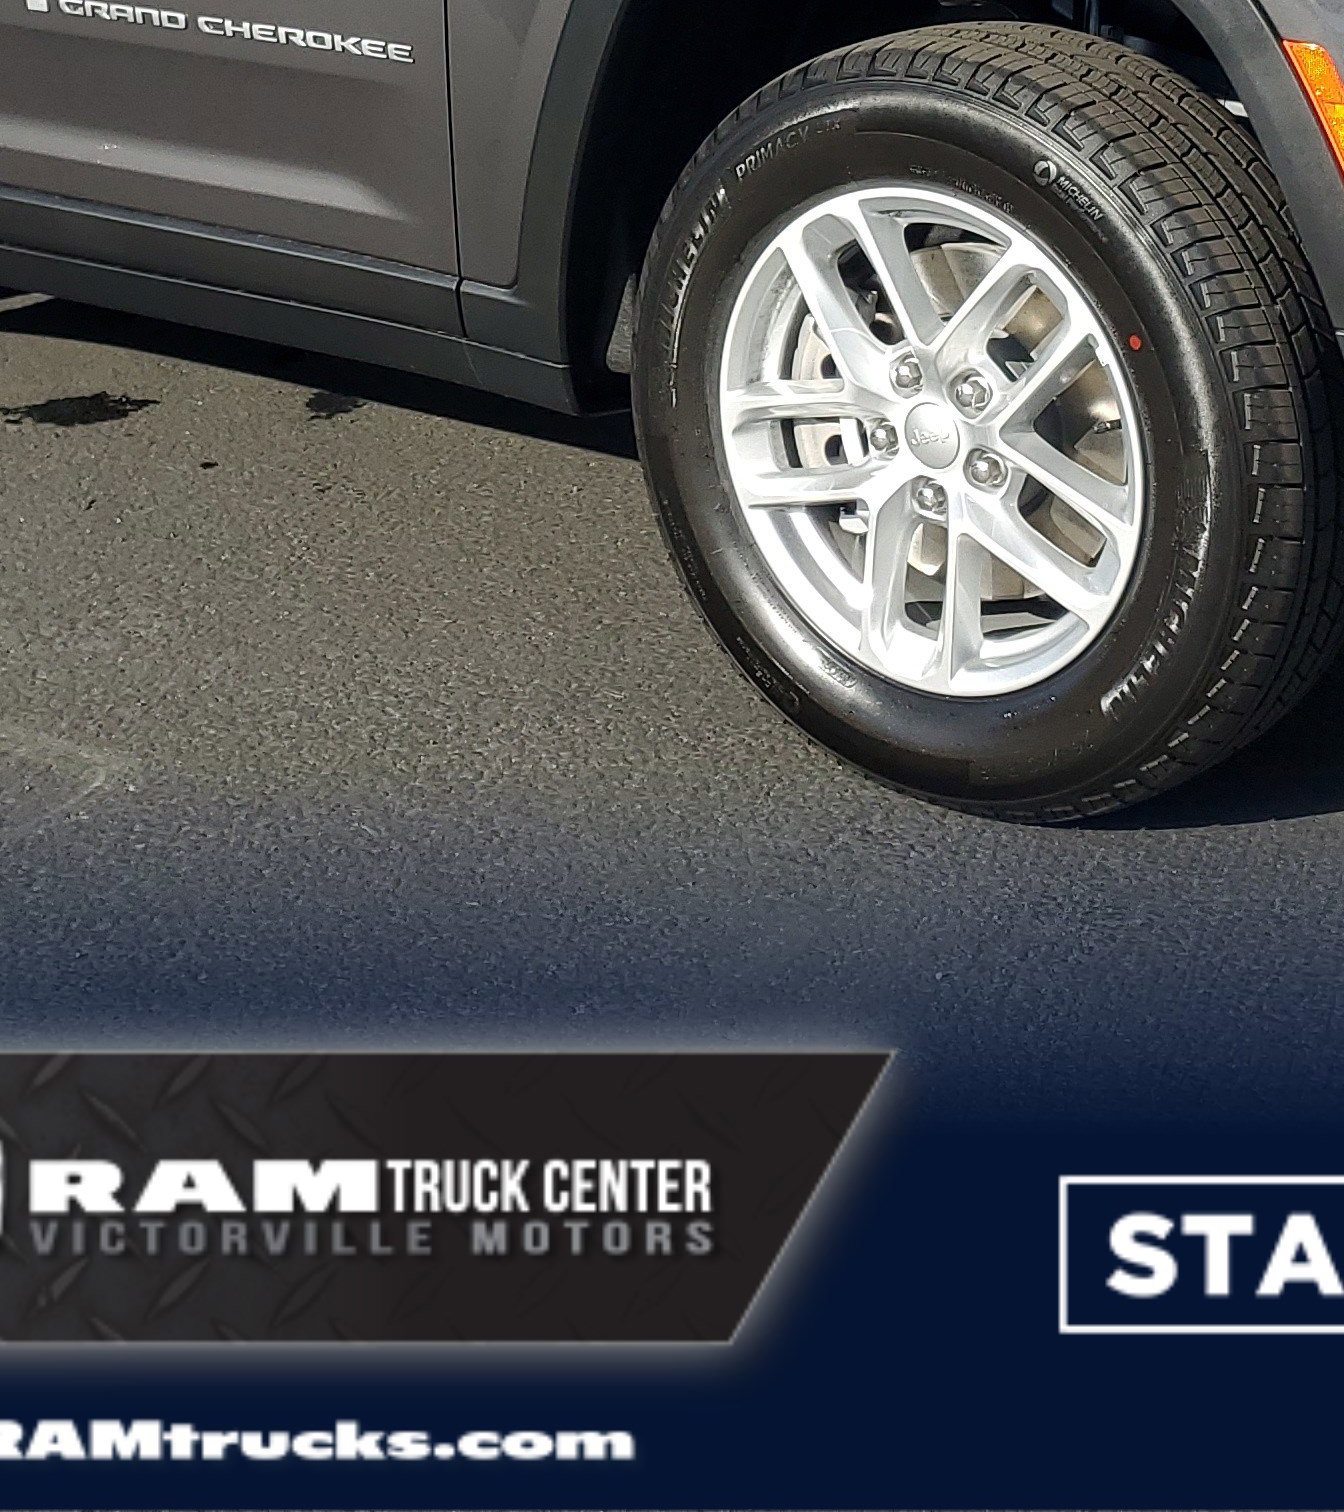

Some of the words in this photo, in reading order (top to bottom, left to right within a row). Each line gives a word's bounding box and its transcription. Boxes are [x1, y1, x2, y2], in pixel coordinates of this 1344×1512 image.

[197, 16, 415, 64] CHEROKEE
[736, 126, 809, 181] PRIMACY
[1057, 176, 1104, 221] MICHELIN
